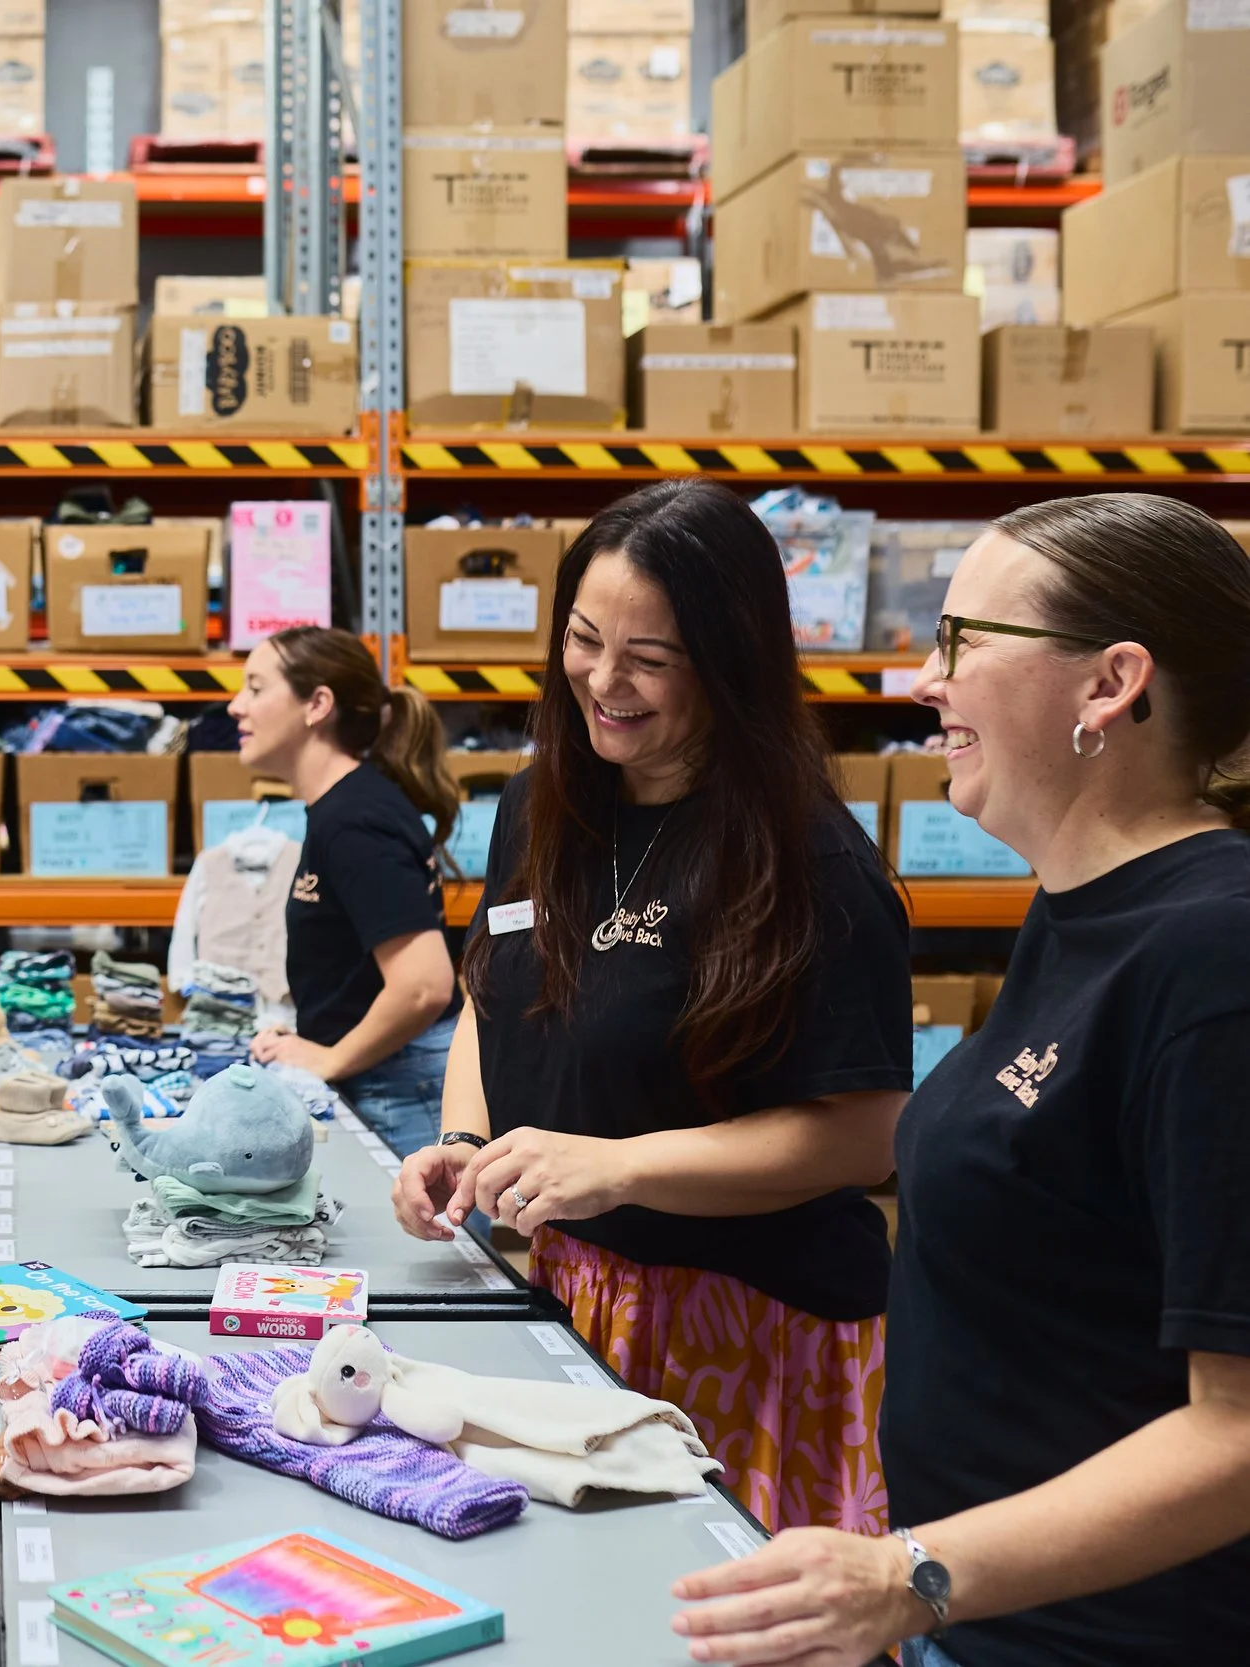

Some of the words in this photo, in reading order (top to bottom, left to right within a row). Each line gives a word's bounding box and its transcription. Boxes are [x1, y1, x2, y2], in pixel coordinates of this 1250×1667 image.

[617, 908, 641, 929] Baby
[635, 927, 663, 948] Back
[25, 1270, 54, 1285] On
[48, 1282, 81, 1298] the
[74, 1294, 121, 1314] Farm
[232, 1271, 259, 1300] WORDS
[256, 1322, 306, 1337] WORDS
